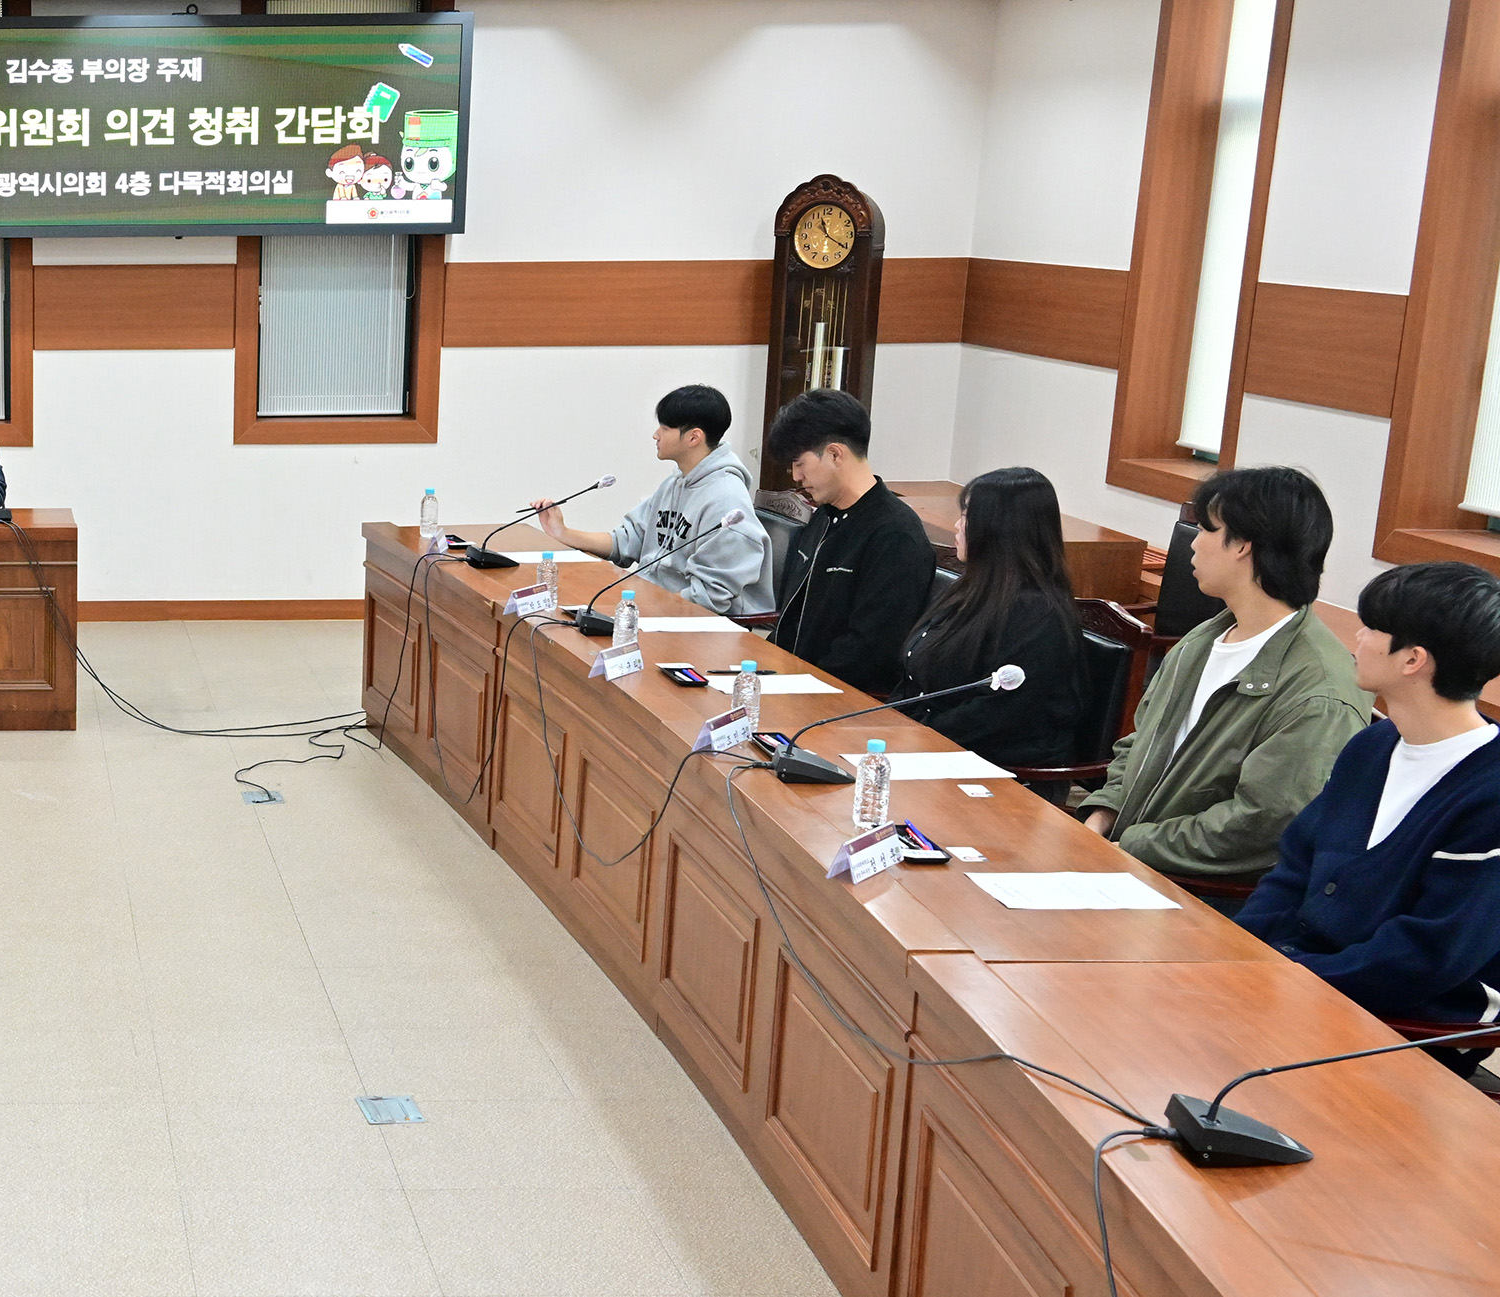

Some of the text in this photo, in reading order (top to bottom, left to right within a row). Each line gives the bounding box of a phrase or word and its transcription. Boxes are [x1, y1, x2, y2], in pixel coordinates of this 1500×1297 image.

[6, 58, 75, 84] 김수종
[80, 57, 151, 84] 부의장
[155, 56, 203, 83] 주재
[103, 107, 175, 147] 의견
[188, 106, 260, 146] 청취
[274, 105, 381, 145] 간담회
[114, 170, 152, 197] 4층
[158, 169, 293, 196] 다목적회의실
[823, 207, 833, 216] 12
[804, 221, 813, 229] 10
[844, 219, 851, 227] 2
[801, 232, 808, 240] 9
[846, 231, 854, 239] 3
[803, 243, 811, 251] 8
[811, 251, 819, 260] 7
[822, 254, 829, 263] 6
